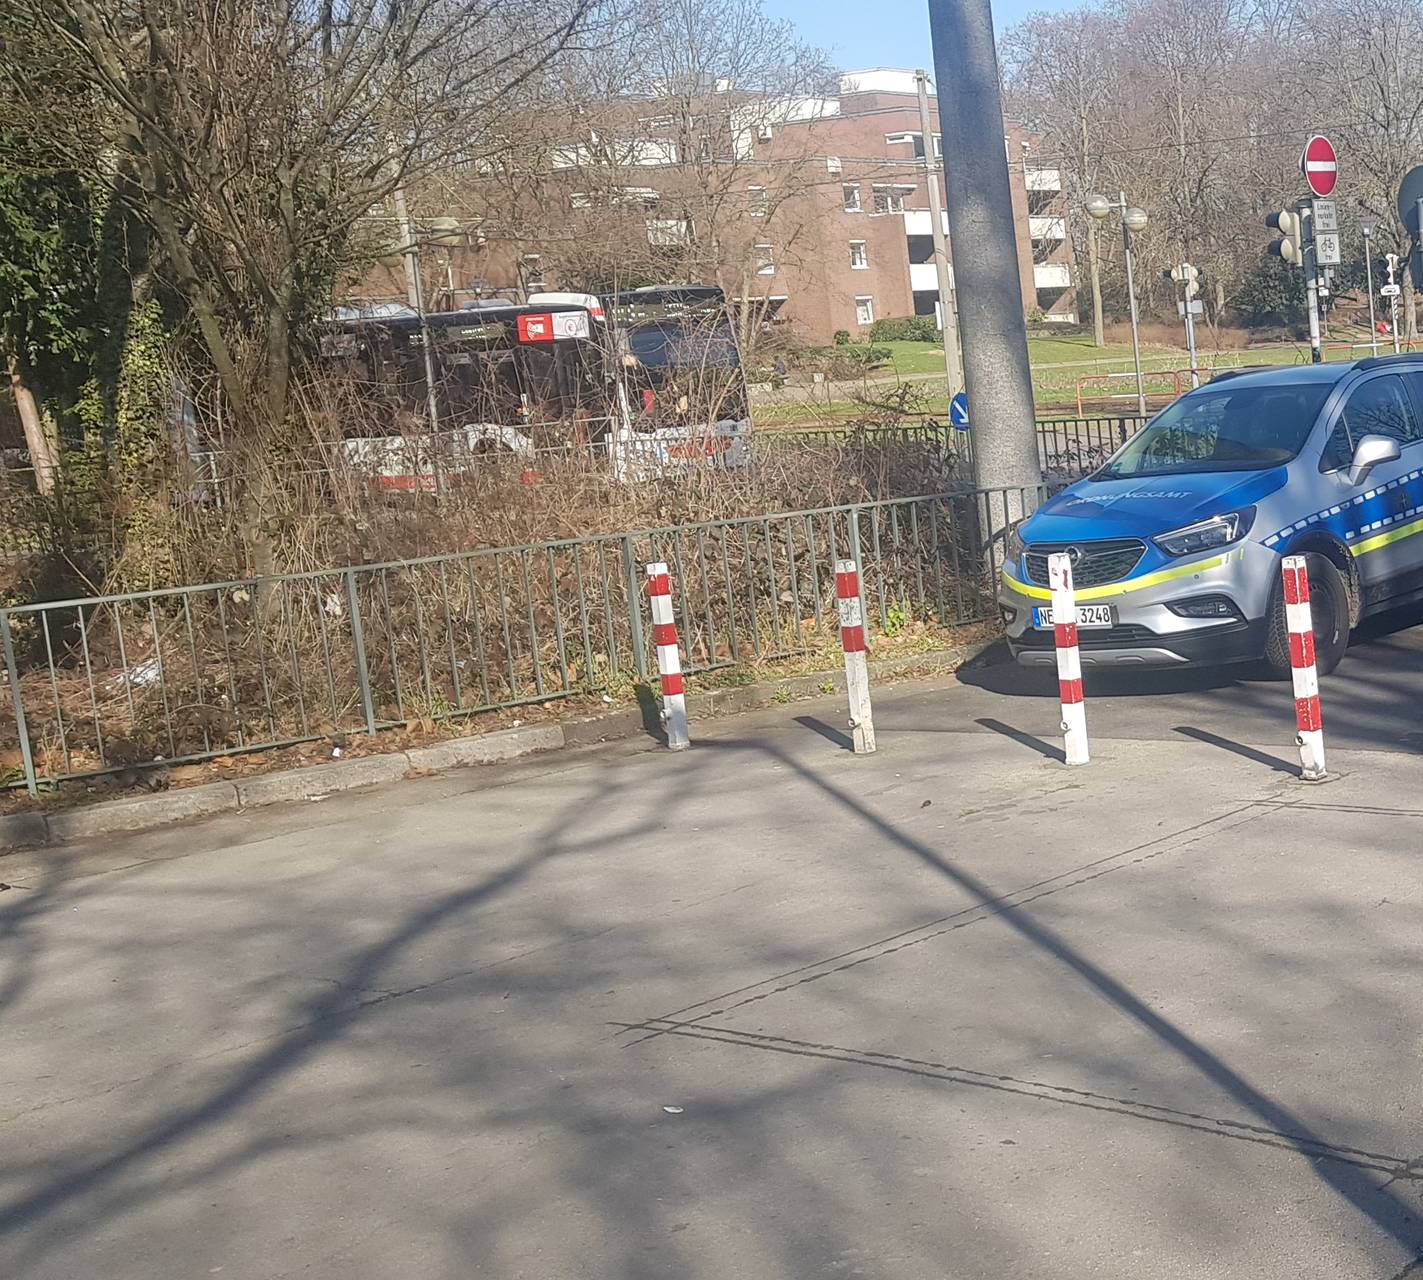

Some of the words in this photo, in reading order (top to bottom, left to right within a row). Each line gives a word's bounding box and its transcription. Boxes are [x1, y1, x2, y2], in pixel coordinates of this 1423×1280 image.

[1065, 488, 1193, 507] ORDNUNGSAMT
[1039, 608, 1054, 625] NE
[1079, 607, 1111, 624] 3248
